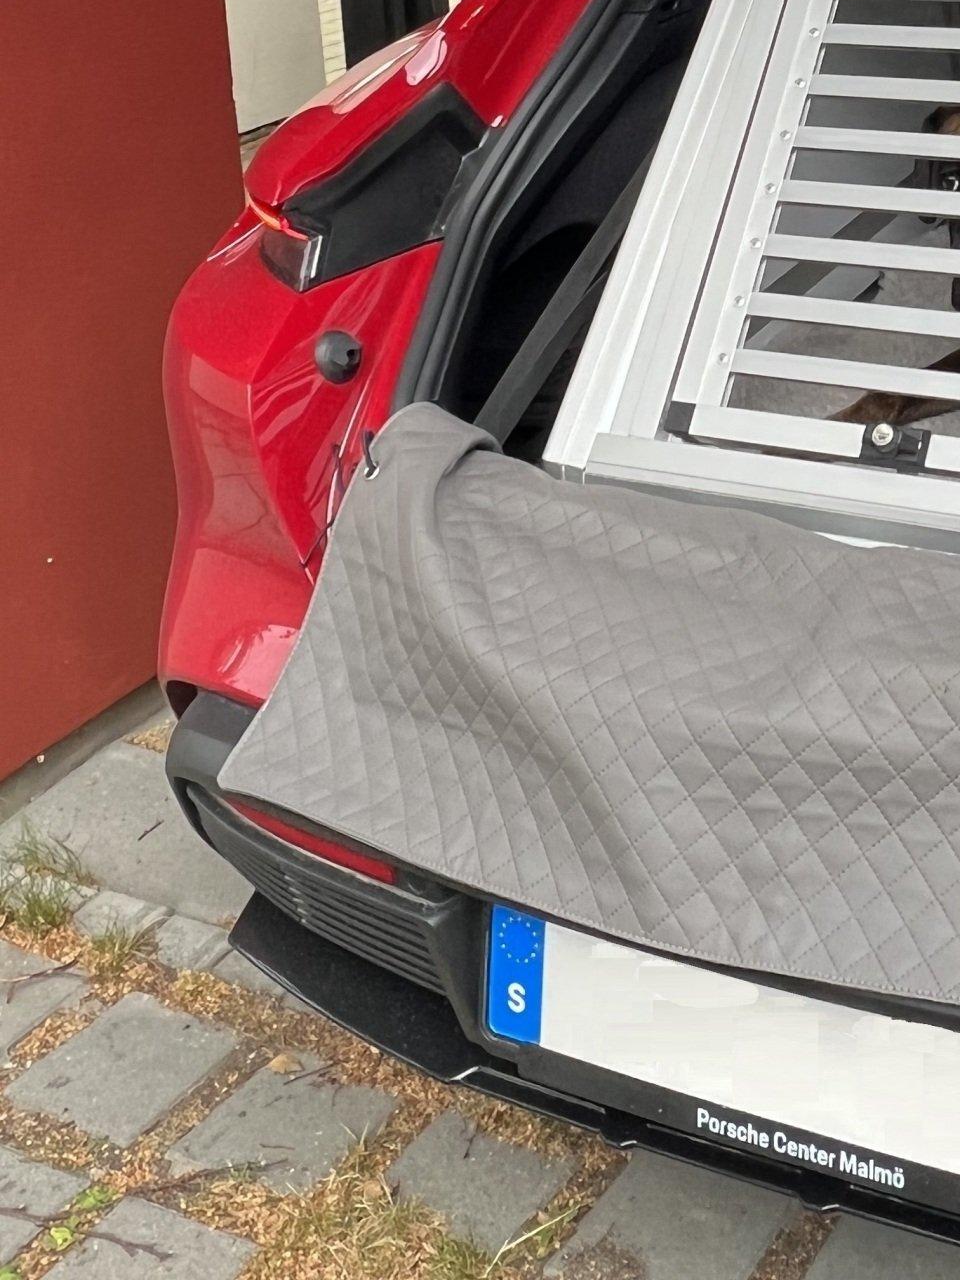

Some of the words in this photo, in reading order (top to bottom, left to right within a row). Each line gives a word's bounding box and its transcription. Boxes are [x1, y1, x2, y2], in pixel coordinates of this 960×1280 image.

[507, 981, 527, 1014] S
[696, 1107, 770, 1149] Porsche
[773, 1131, 837, 1169] Center
[839, 1150, 906, 1190] Malmö
